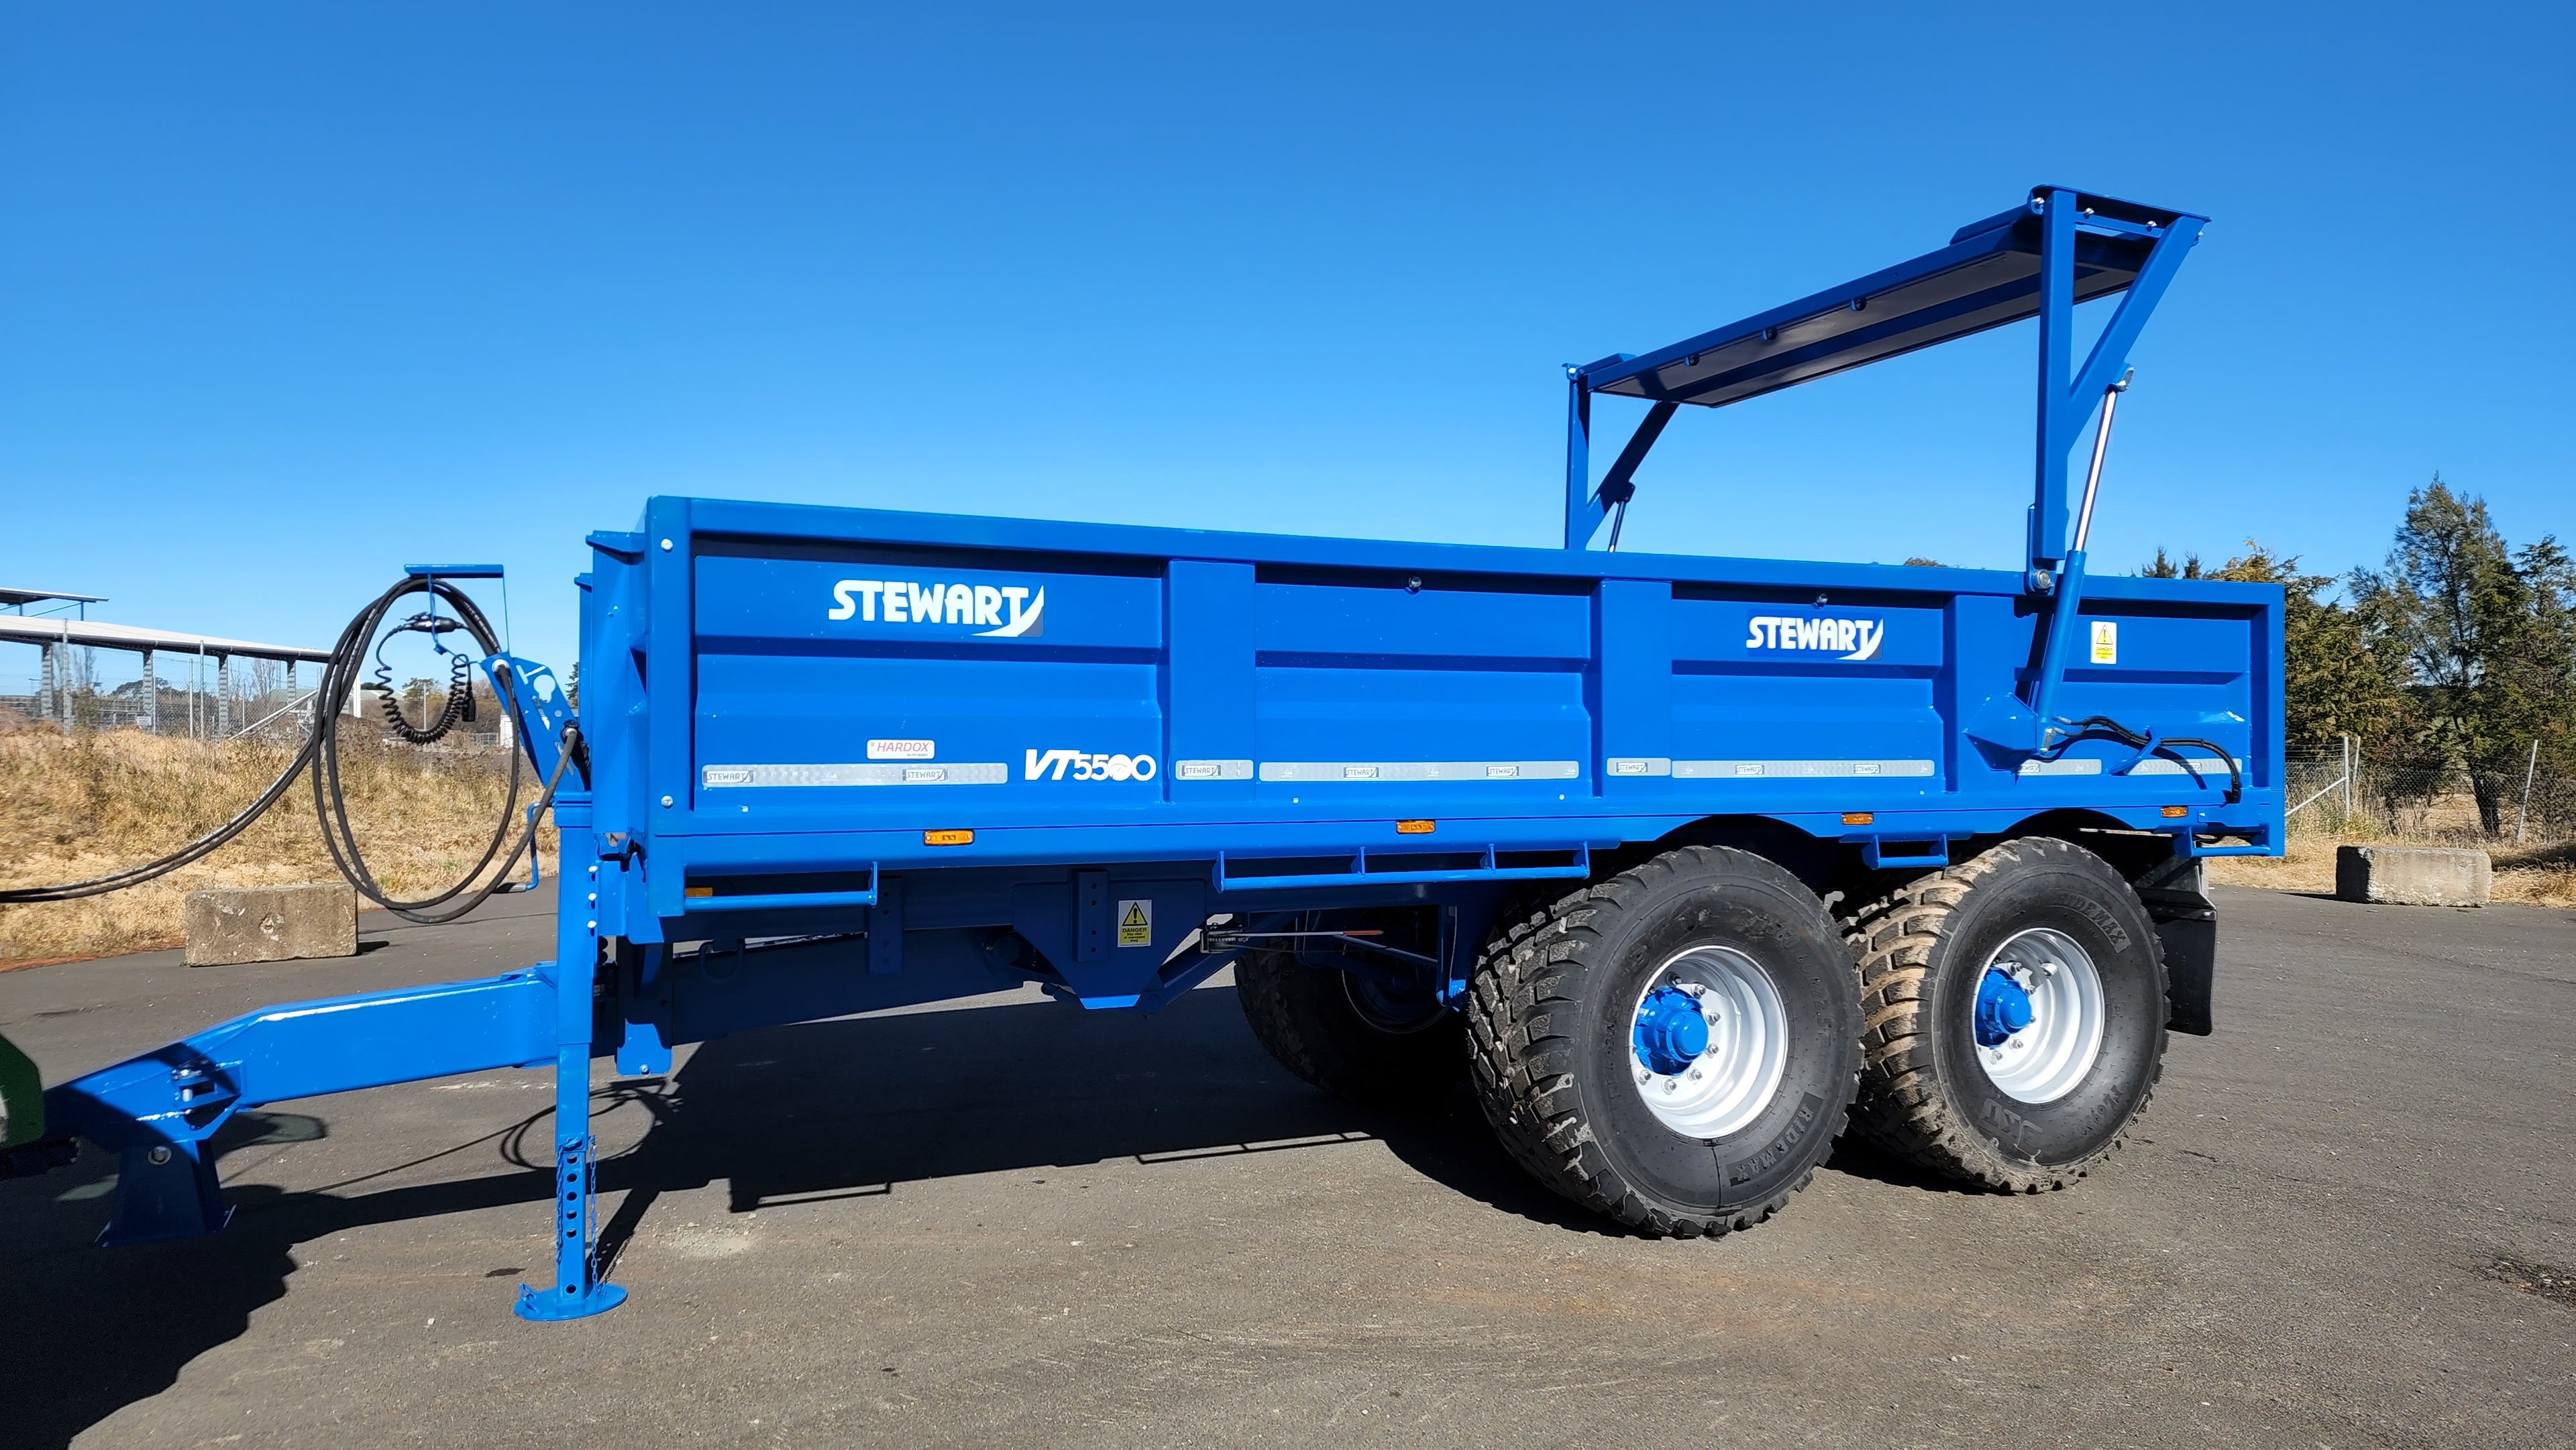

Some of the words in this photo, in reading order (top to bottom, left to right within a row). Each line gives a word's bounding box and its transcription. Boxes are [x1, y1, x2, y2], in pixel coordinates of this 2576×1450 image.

[828, 580, 1044, 636] STEWART
[1746, 616, 1883, 660] STEWART
[877, 742, 930, 752] HARDOX
[708, 773, 747, 781] STEWART
[1024, 749, 1157, 781] VT5500
[1776, 1103, 1815, 1156] RIDE
[1735, 1148, 1778, 1183] MAX
